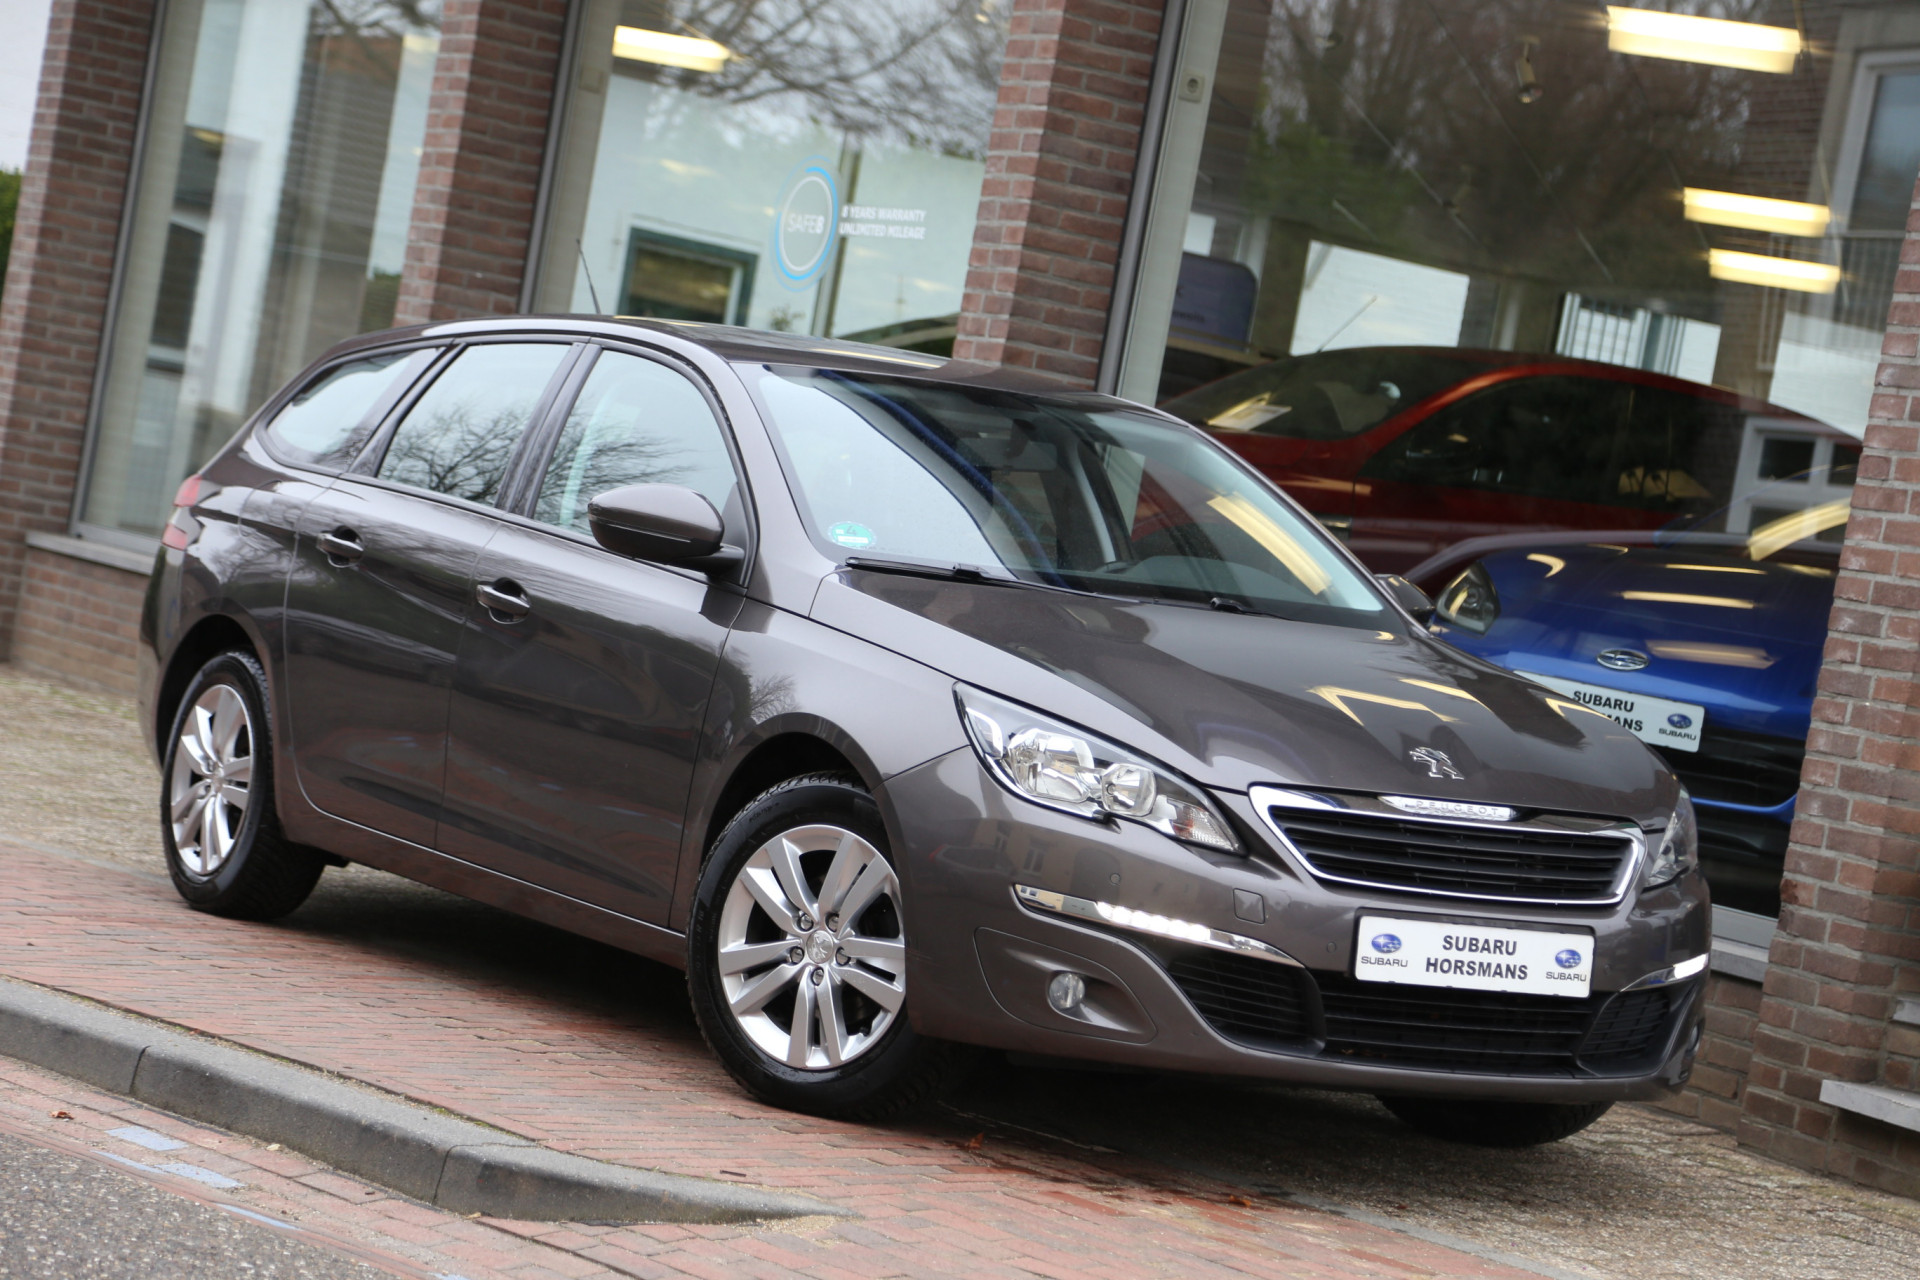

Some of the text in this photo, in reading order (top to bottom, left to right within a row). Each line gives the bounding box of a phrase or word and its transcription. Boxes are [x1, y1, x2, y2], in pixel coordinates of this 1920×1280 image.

[849, 205, 877, 220] YEARS
[877, 207, 927, 222] WARRANTY
[838, 221, 926, 240] UNLIMITED MILEAGE
[1573, 690, 1634, 713] SUBARU
[1658, 727, 1697, 741] SUBARU
[1415, 800, 1499, 816] PEUGEOT
[1442, 934, 1518, 956] SUBARU
[1360, 955, 1409, 968] SUBARU
[1425, 957, 1528, 981] HORSMANS
[1545, 971, 1587, 982] SUBARU
